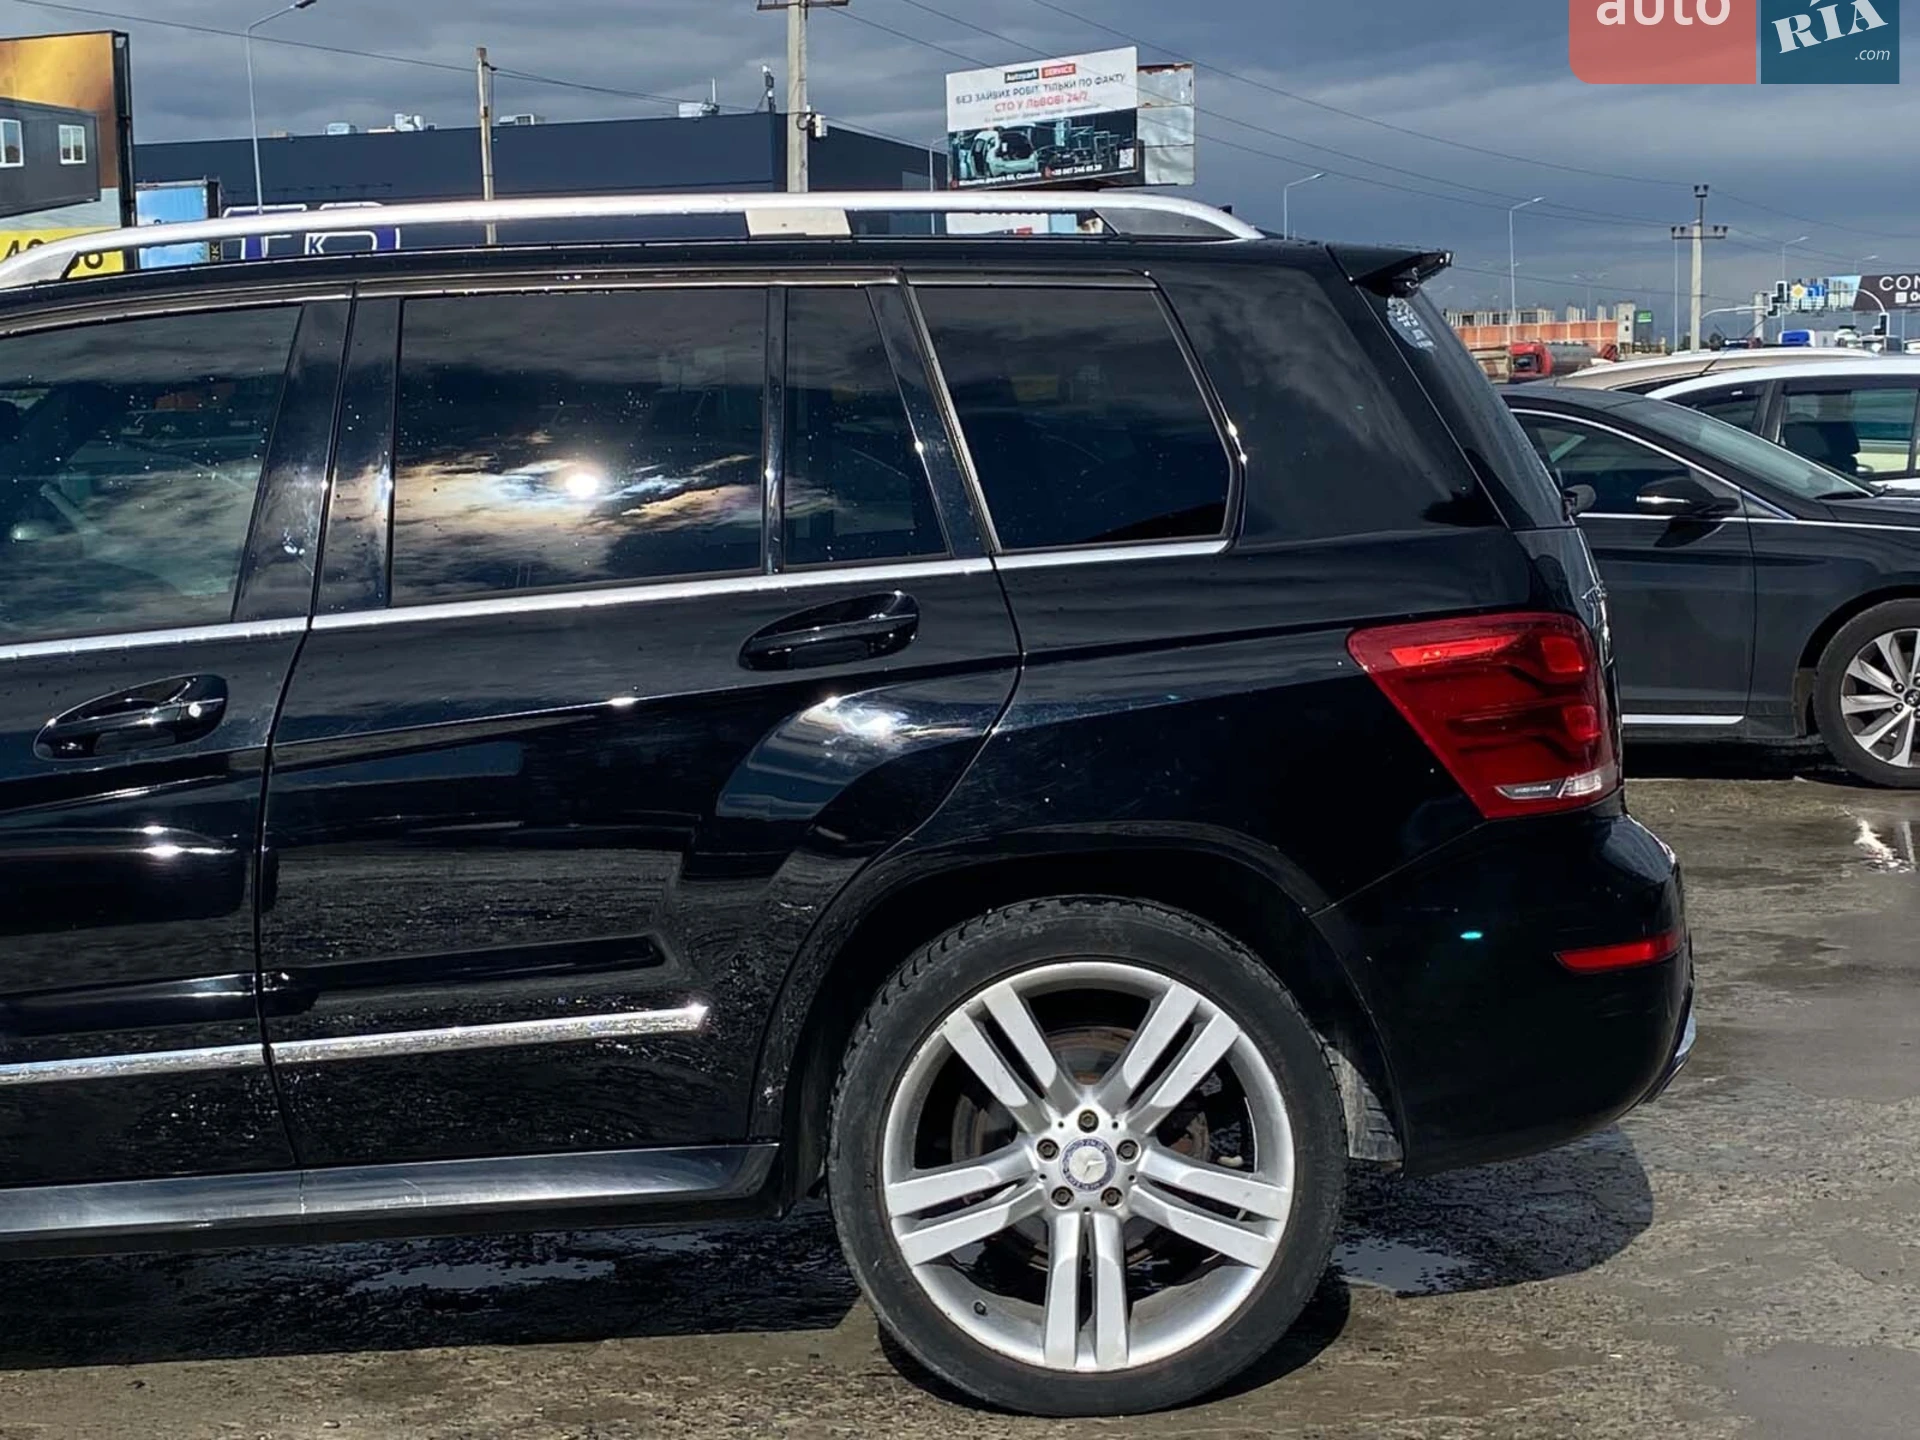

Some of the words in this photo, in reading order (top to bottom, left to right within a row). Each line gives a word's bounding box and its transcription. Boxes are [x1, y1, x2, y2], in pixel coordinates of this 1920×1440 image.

[955, 94, 973, 105] БЕЗ
[975, 88, 1011, 102] ЗАЙВИХ
[1044, 79, 1076, 92] ТІЛЬКИ
[1078, 76, 1092, 87] ПО
[1093, 72, 1125, 86] ФАКТУ
[995, 100, 1015, 113] СТО
[1017, 99, 1025, 110] У
[1026, 95, 1065, 109] ЛЬВОВІ
[1067, 91, 1089, 103] 24/7
